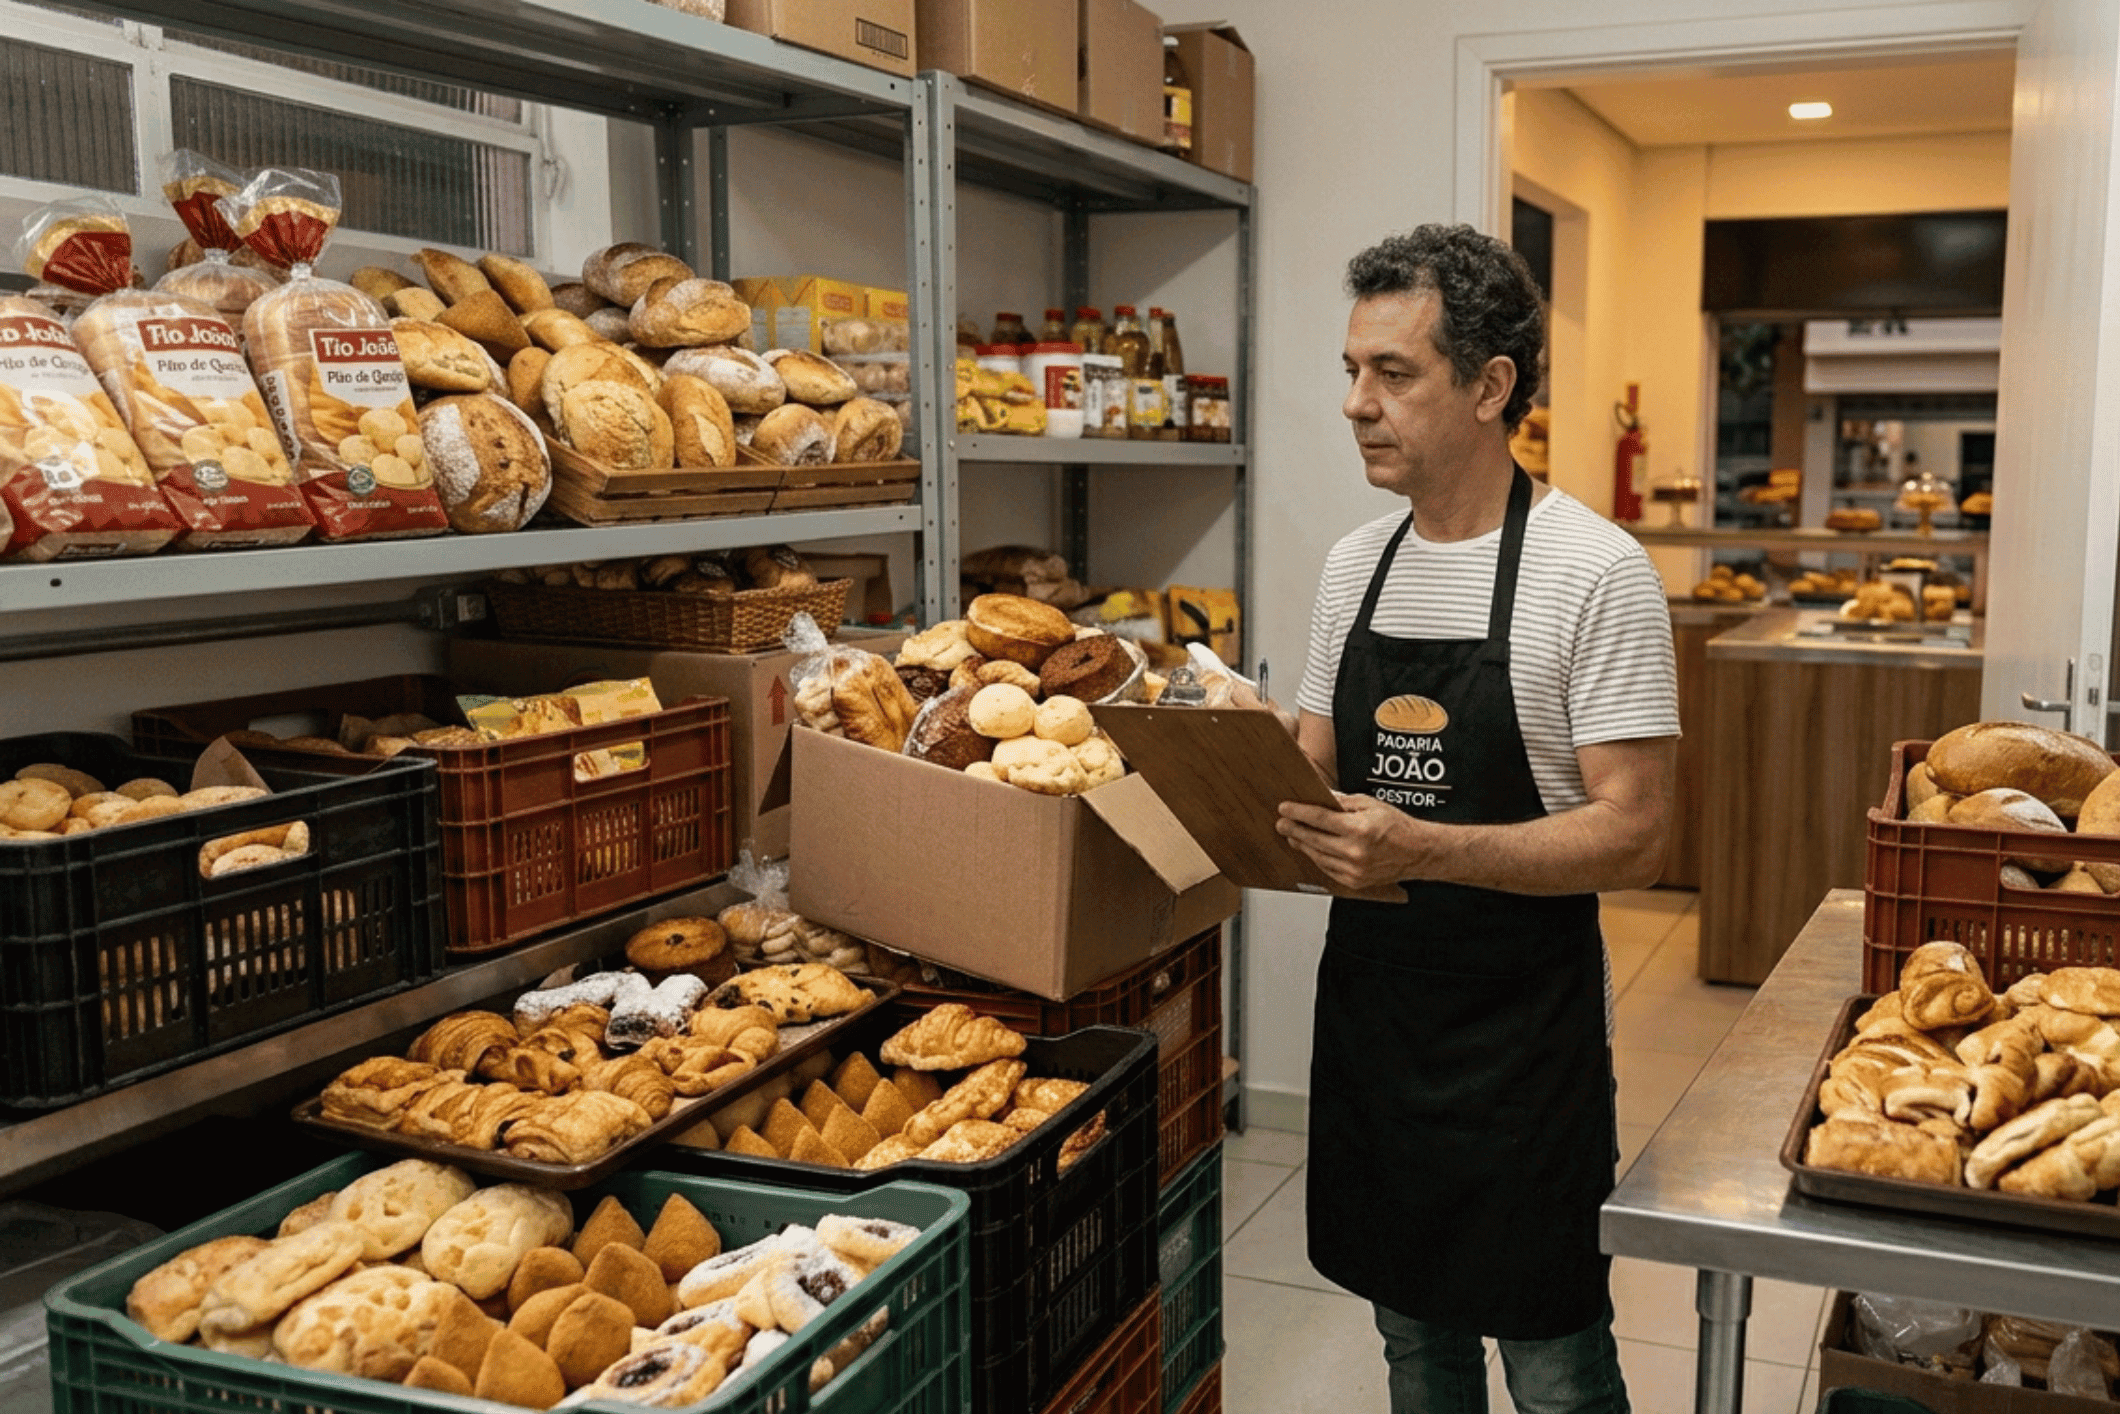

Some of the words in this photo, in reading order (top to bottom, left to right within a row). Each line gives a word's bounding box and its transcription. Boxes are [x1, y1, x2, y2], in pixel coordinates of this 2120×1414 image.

[190, 358, 207, 370] de
[355, 370, 369, 383] de
[1371, 751, 1445, 781] JOÃO
